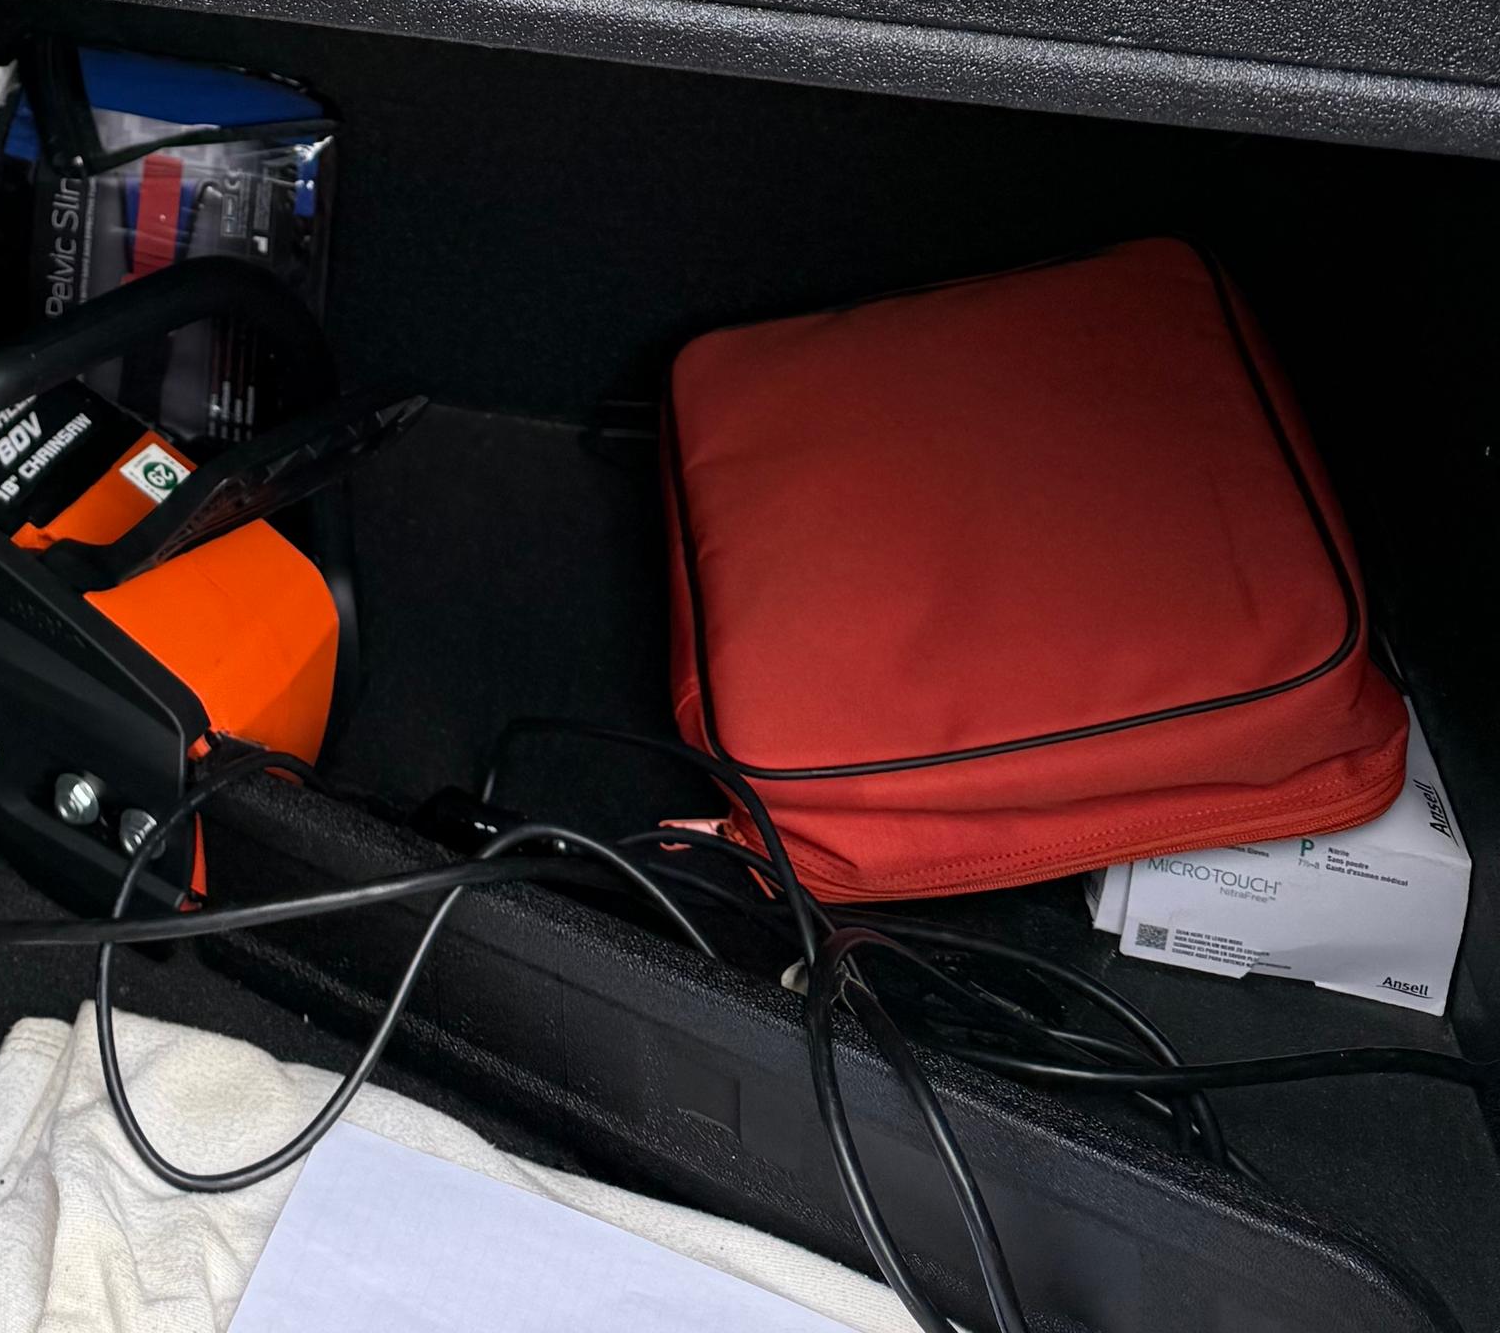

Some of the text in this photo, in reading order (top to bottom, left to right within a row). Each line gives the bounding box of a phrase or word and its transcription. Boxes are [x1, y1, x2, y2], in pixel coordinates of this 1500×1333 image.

[45, 177, 82, 318] Pelvic Slin
[17, 411, 93, 481] CHAINSAW
[1412, 778, 1452, 839] Ansell
[1381, 976, 1429, 996] Ansell
